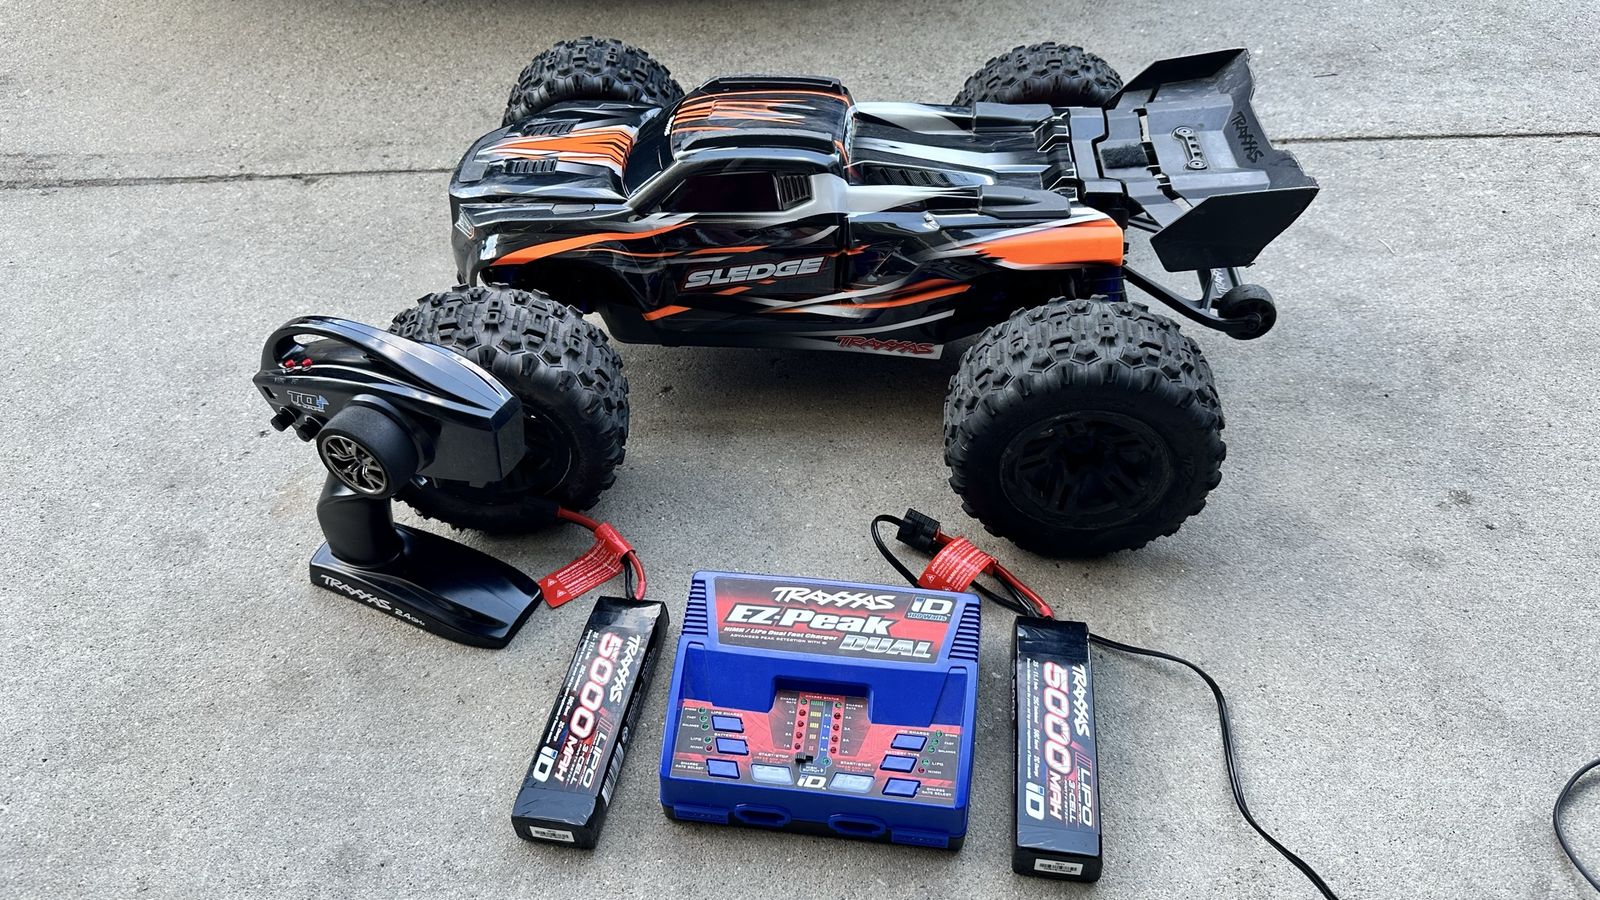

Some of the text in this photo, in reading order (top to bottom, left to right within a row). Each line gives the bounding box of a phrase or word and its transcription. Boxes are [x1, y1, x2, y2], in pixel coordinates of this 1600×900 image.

[1231, 111, 1264, 163] TRAXXAS
[684, 256, 825, 289] SLEDGE
[836, 335, 934, 354] TRAXXAS
[320, 574, 392, 611] TRAXXAS
[770, 586, 896, 611] TRAXXAS
[724, 604, 898, 635] EZ-Peak
[609, 634, 641, 703] TRAXXAS
[838, 634, 932, 658] DUAL
[570, 632, 624, 739] 5000
[1072, 664, 1090, 737] TRAXXAS
[1043, 662, 1072, 774] 5000
[554, 734, 578, 782] MAH
[582, 732, 607, 788] LIPO
[1050, 769, 1062, 820] MAH
[1068, 780, 1076, 823] 3-CELL
[1080, 767, 1092, 827] LIPO
